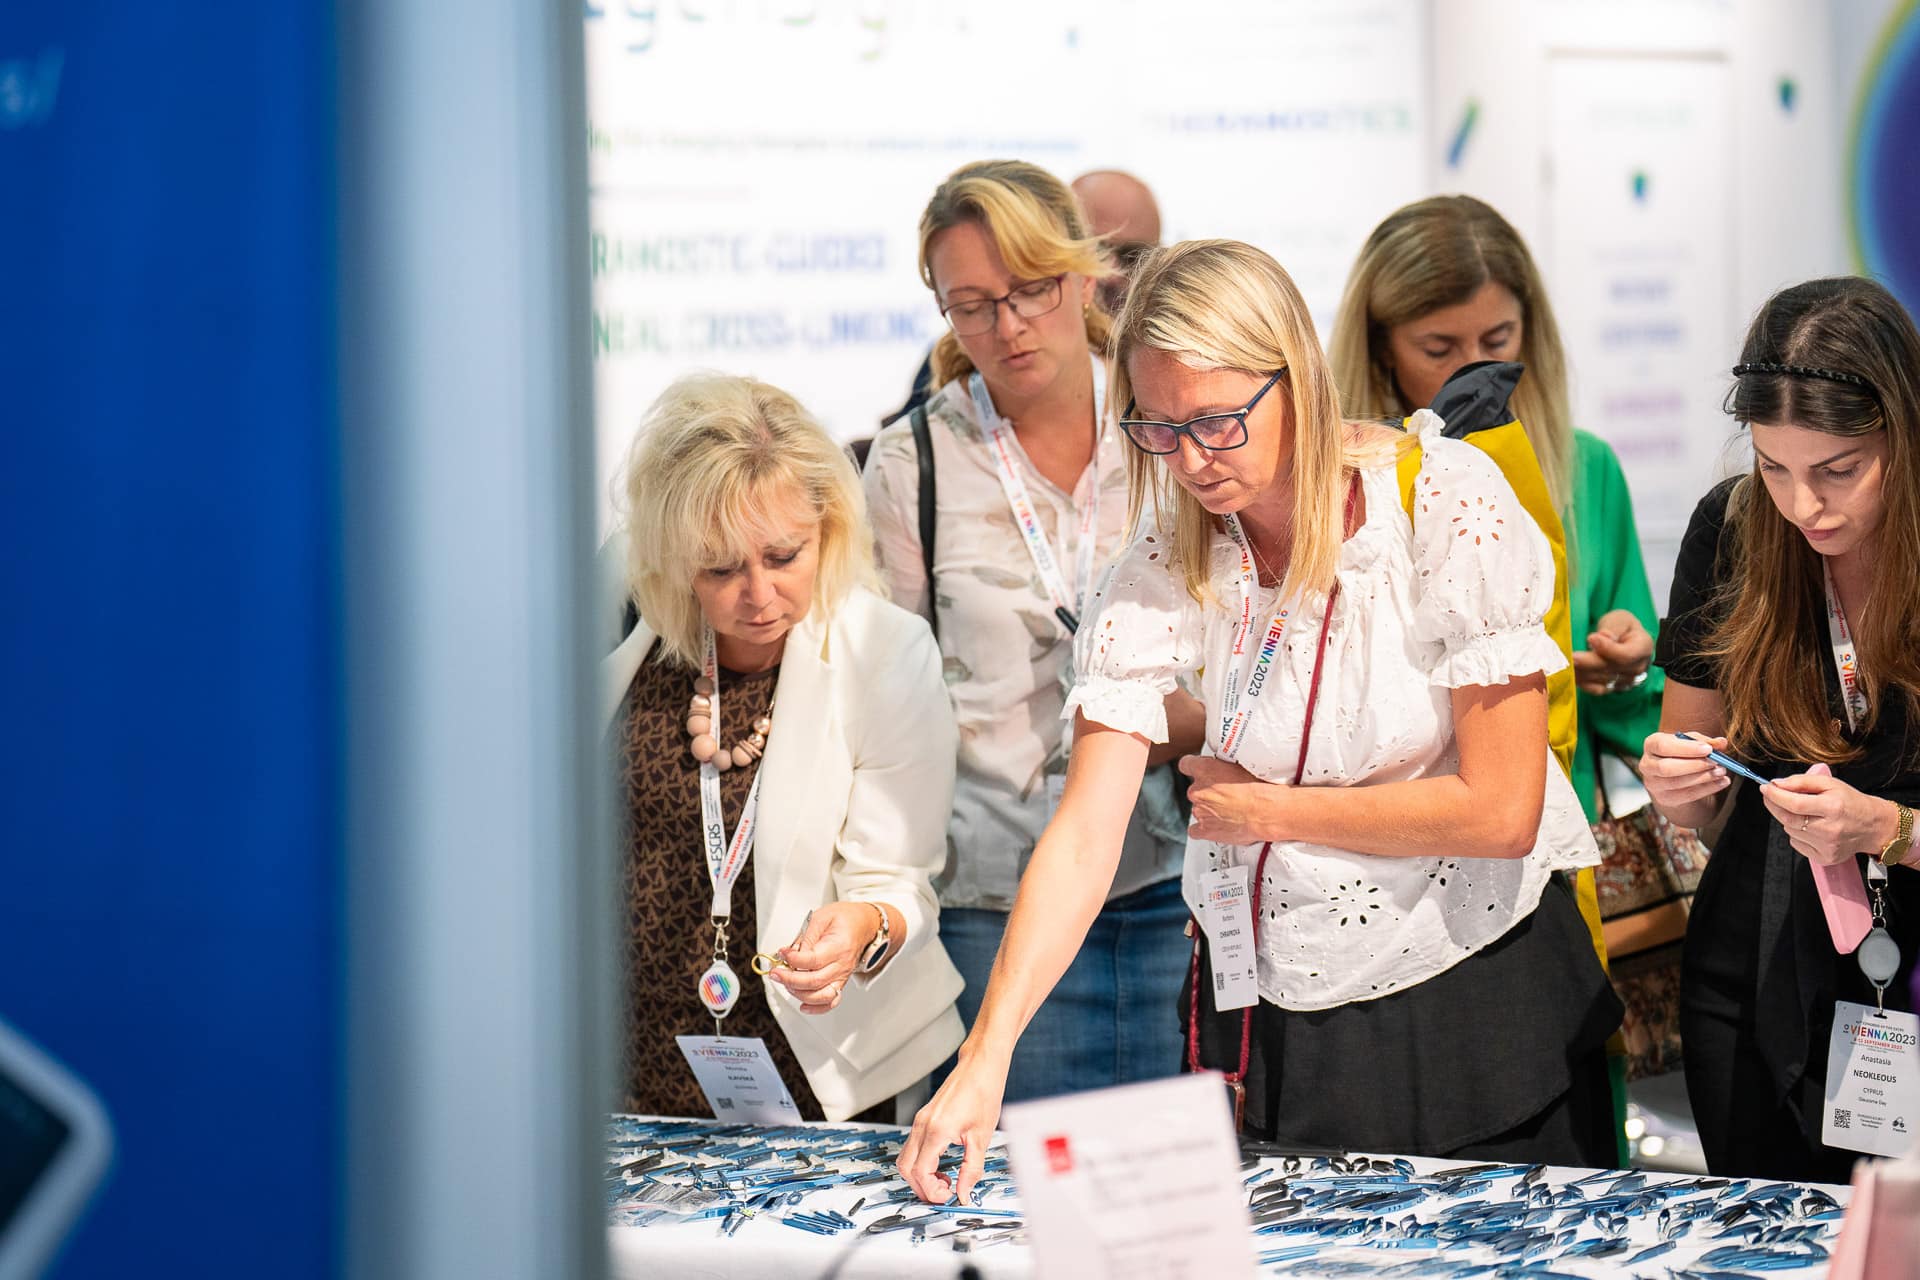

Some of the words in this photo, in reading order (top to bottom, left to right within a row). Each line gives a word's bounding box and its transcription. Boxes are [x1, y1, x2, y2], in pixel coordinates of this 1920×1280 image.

[1247, 618, 1285, 698] VIENNA2023
[1849, 1024, 1916, 1046] VIENNA2023
[1860, 1054, 1892, 1066] Anastasia
[1853, 1069, 1897, 1084] NEOKLEOUS
[1862, 1087, 1884, 1097] CYPRUS
